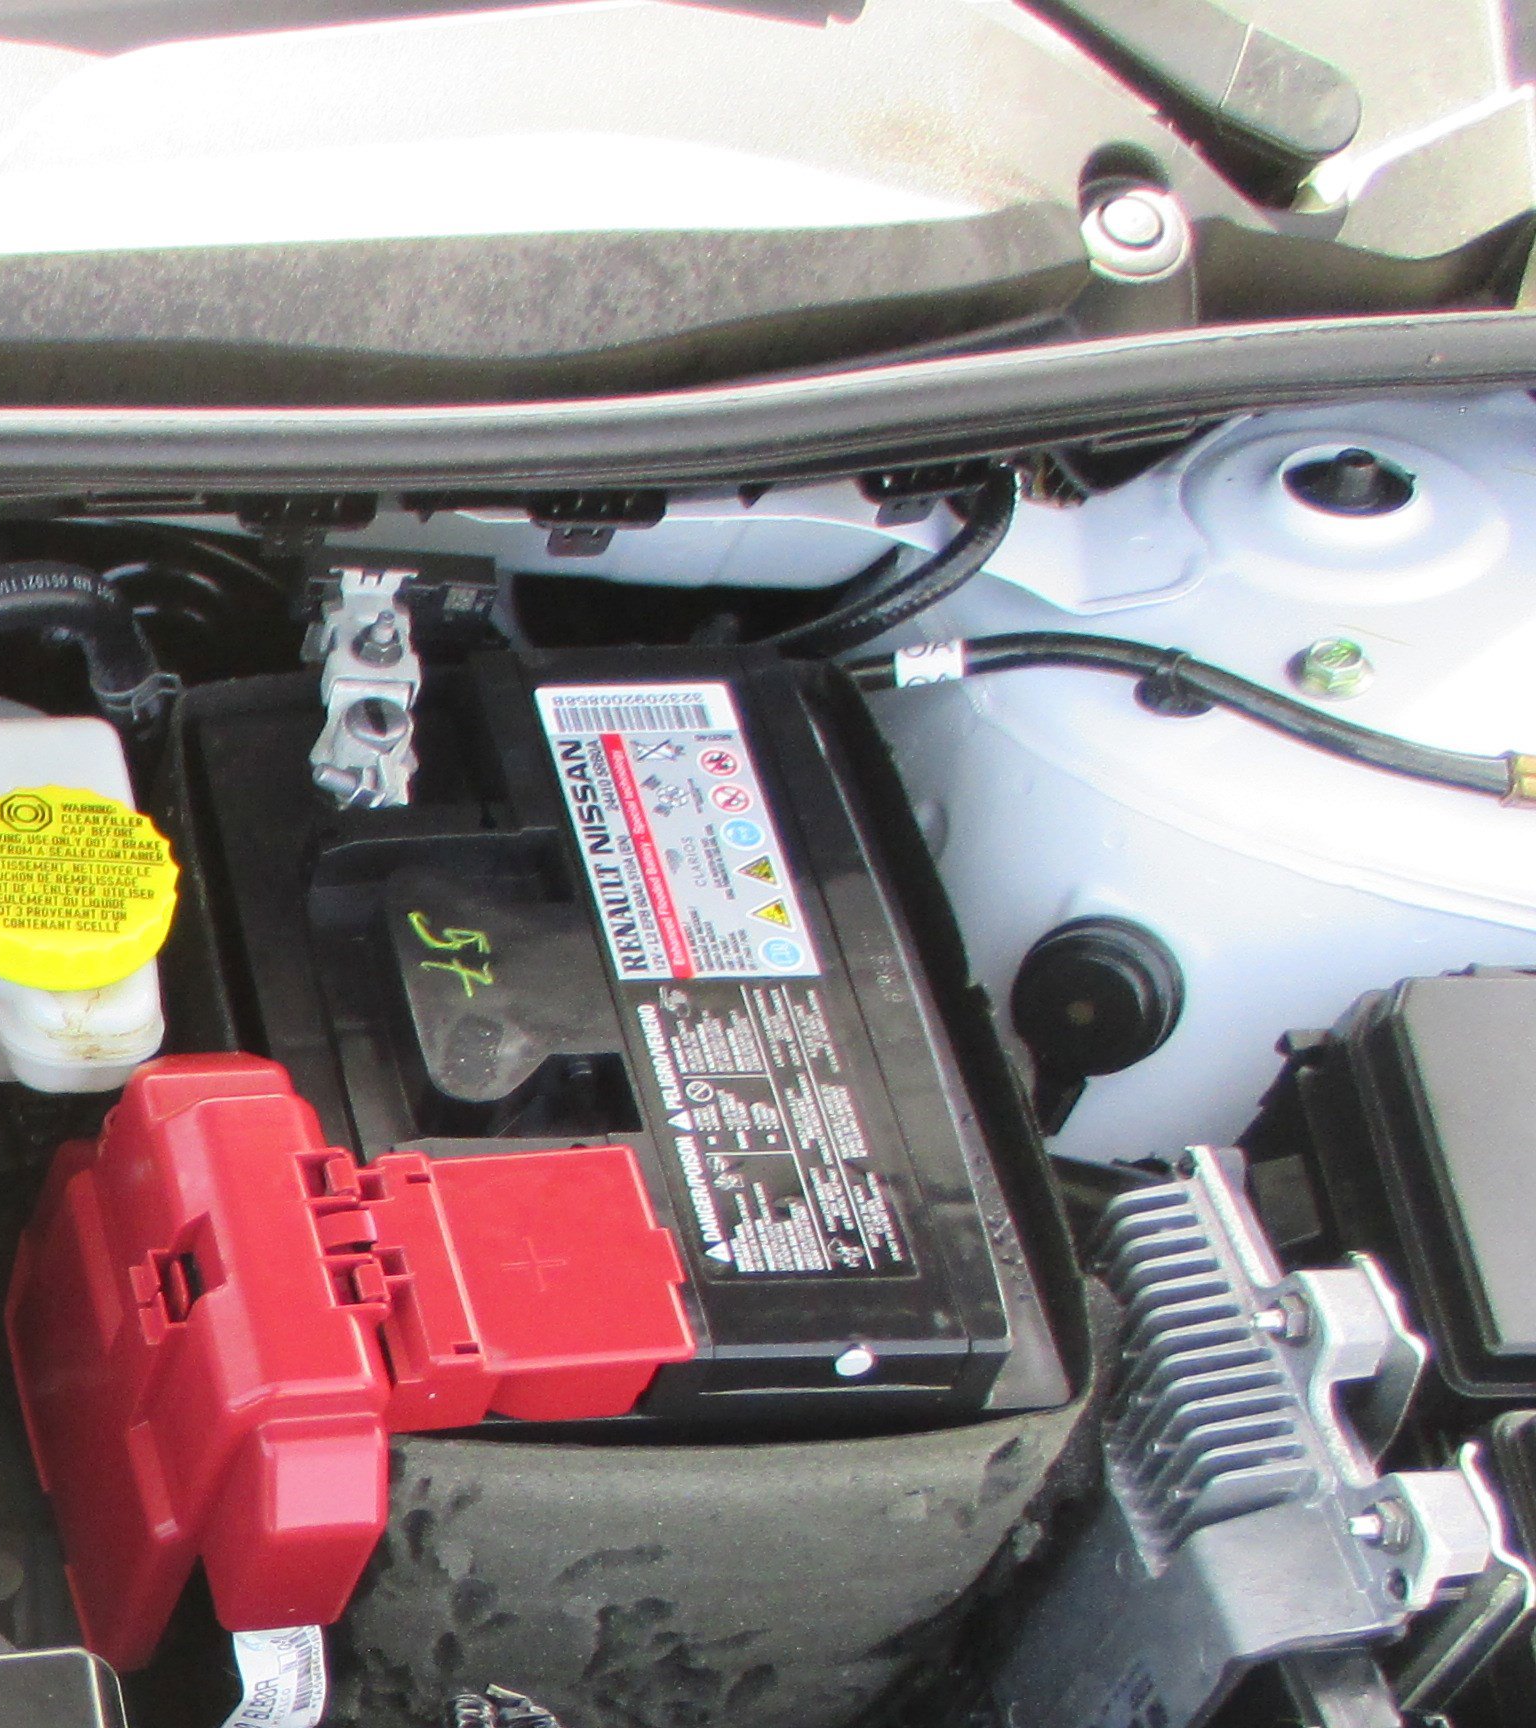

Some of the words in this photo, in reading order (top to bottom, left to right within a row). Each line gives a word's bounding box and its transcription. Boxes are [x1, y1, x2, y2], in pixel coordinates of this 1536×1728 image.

[556, 739, 614, 855] NISSAN
[61, 813, 100, 826] CLEAN
[103, 815, 144, 828] FILLER
[61, 825, 85, 836] CAP
[91, 825, 134, 837] BEFORE
[27, 834, 49, 845] USE
[52, 836, 81, 846] ONLY
[85, 837, 108, 848] DOT
[122, 838, 162, 850] BRAKE
[0, 843, 32, 855] FROM
[35, 845, 45, 855] A
[49, 845, 96, 858] SEALED
[73, 863, 134, 876] NETTOYER
[137, 866, 152, 878] LE
[37, 873, 50, 884] DE
[56, 874, 139, 887] REMPLISSAGE
[13, 883, 27, 893] DE
[63, 896, 78, 907] DU
[82, 897, 126, 909] LIQUIDE
[26, 906, 97, 920] PROVENANT
[593, 861, 650, 973] RENAULT
[3, 918, 72, 931] CONTENANT
[637, 1004, 684, 1110] PELIGRO/VENENO
[674, 1135, 723, 1243] DANGER/POISON
